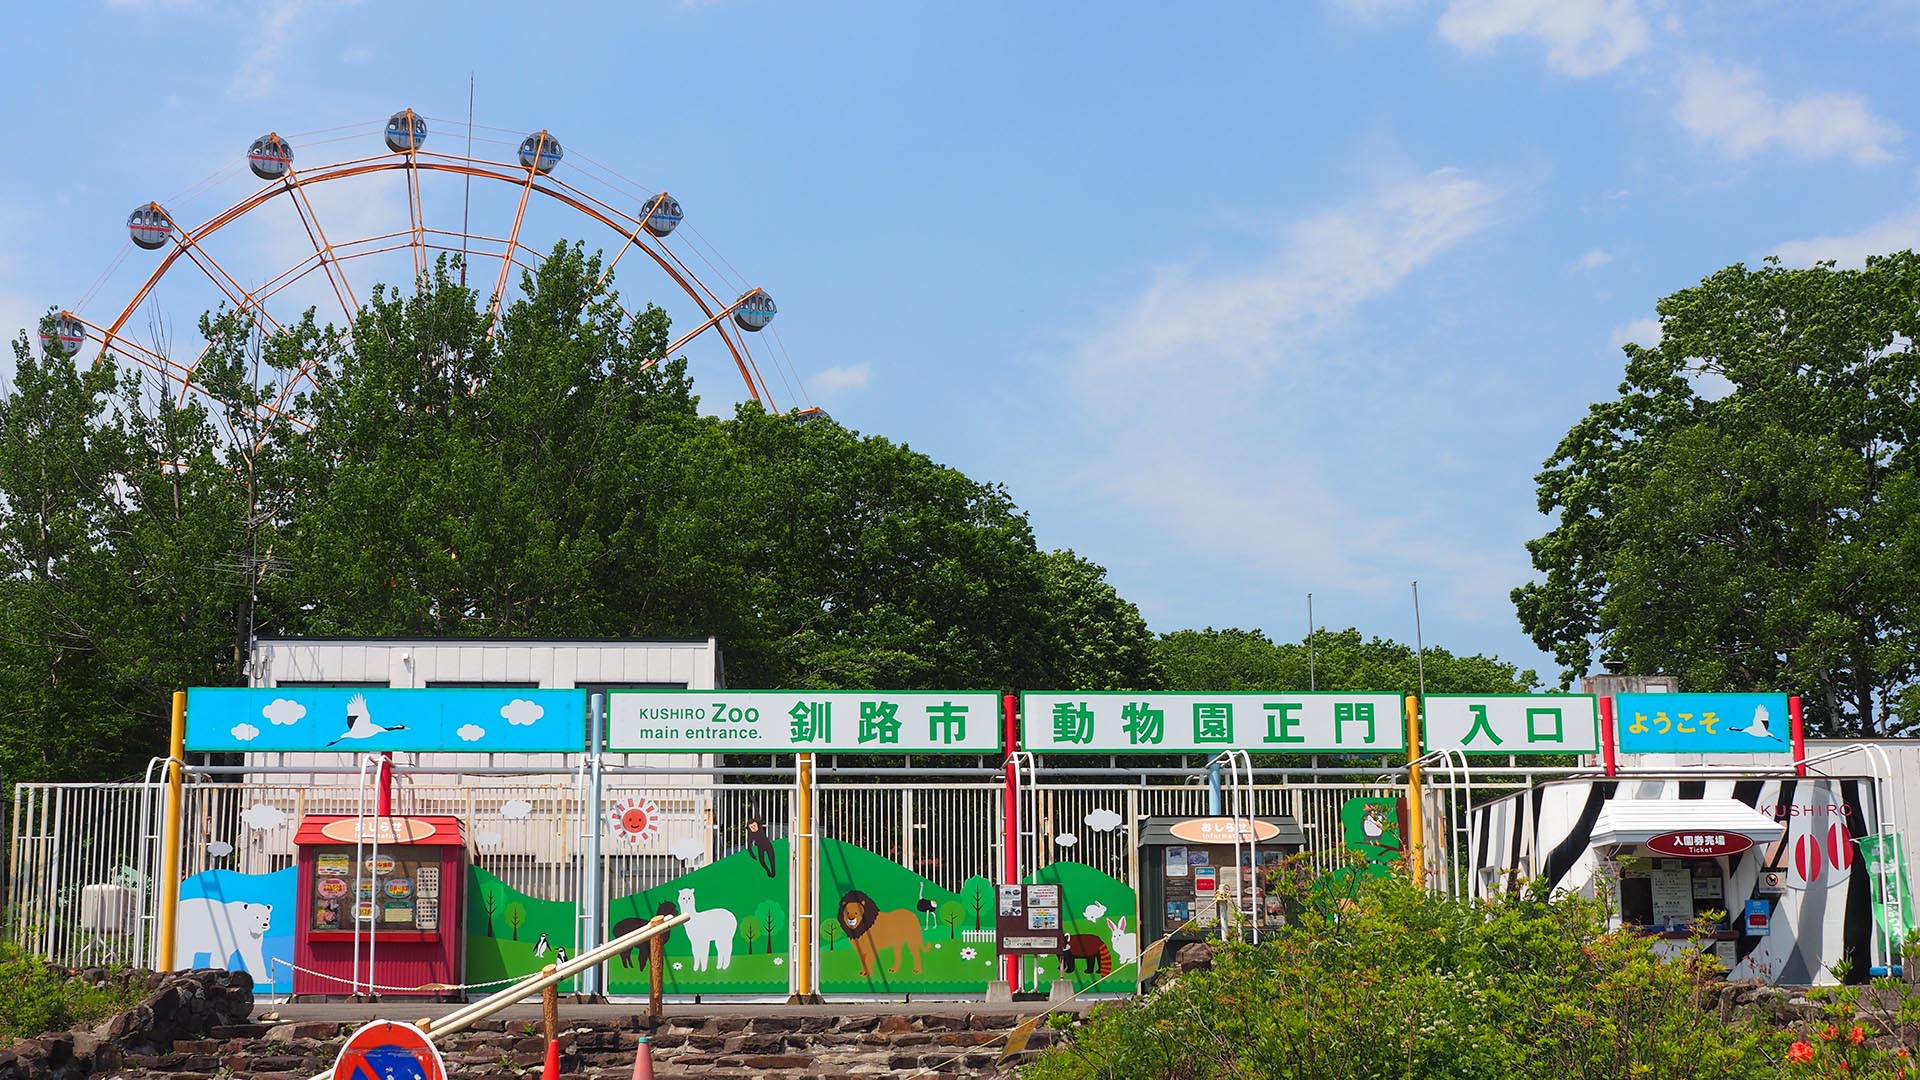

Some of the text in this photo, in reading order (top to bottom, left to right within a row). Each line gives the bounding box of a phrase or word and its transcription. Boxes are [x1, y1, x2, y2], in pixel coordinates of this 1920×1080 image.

[159, 231, 165, 239] 2
[70, 341, 76, 349] 3
[639, 703, 760, 724] KUSHIRO Zoo
[788, 700, 970, 745] 釧路市
[1052, 701, 1377, 746] 動物園正門
[1460, 703, 1565, 747] 入口
[1628, 712, 1720, 735] ようこそ
[640, 726, 763, 740] main entrance.
[1761, 803, 1853, 817] KUSHIRO
[354, 822, 403, 832] おしらせ
[1673, 835, 1726, 846] 入園券売場
[1688, 846, 1713, 854] Ticket
